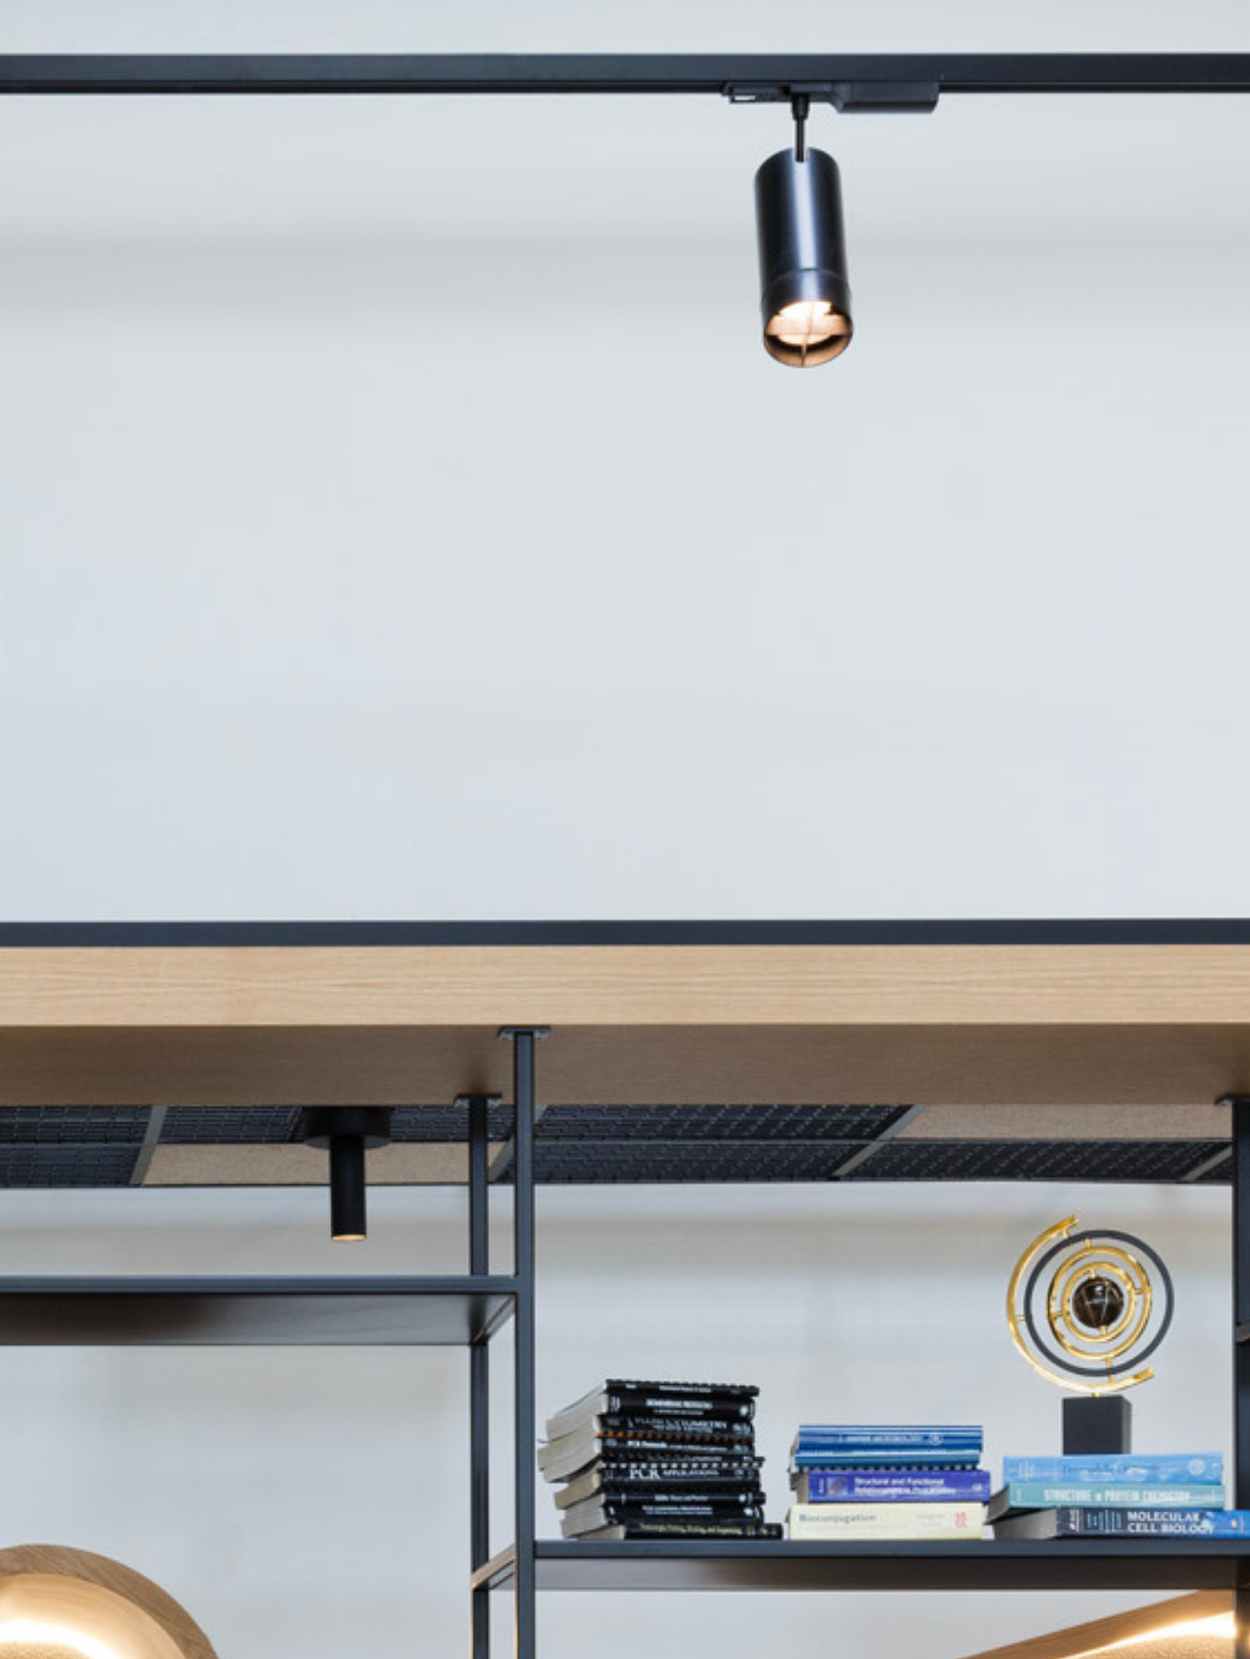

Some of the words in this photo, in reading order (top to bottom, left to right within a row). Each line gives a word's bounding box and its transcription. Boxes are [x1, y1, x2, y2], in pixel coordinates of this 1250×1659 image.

[630, 1470, 660, 1479] PCR
[854, 1477, 888, 1485] Structural
[892, 1477, 904, 1485] and
[907, 1477, 944, 1485] Functional
[1043, 1489, 1092, 1502] STRUCTURE
[1105, 1490, 1139, 1502] PROTEIN
[799, 1513, 876, 1524] Bioconjugation
[1127, 1511, 1199, 1522] MOLECULAR
[1127, 1523, 1158, 1534] CELL
[1161, 1523, 1214, 1535] BIOLOGY
